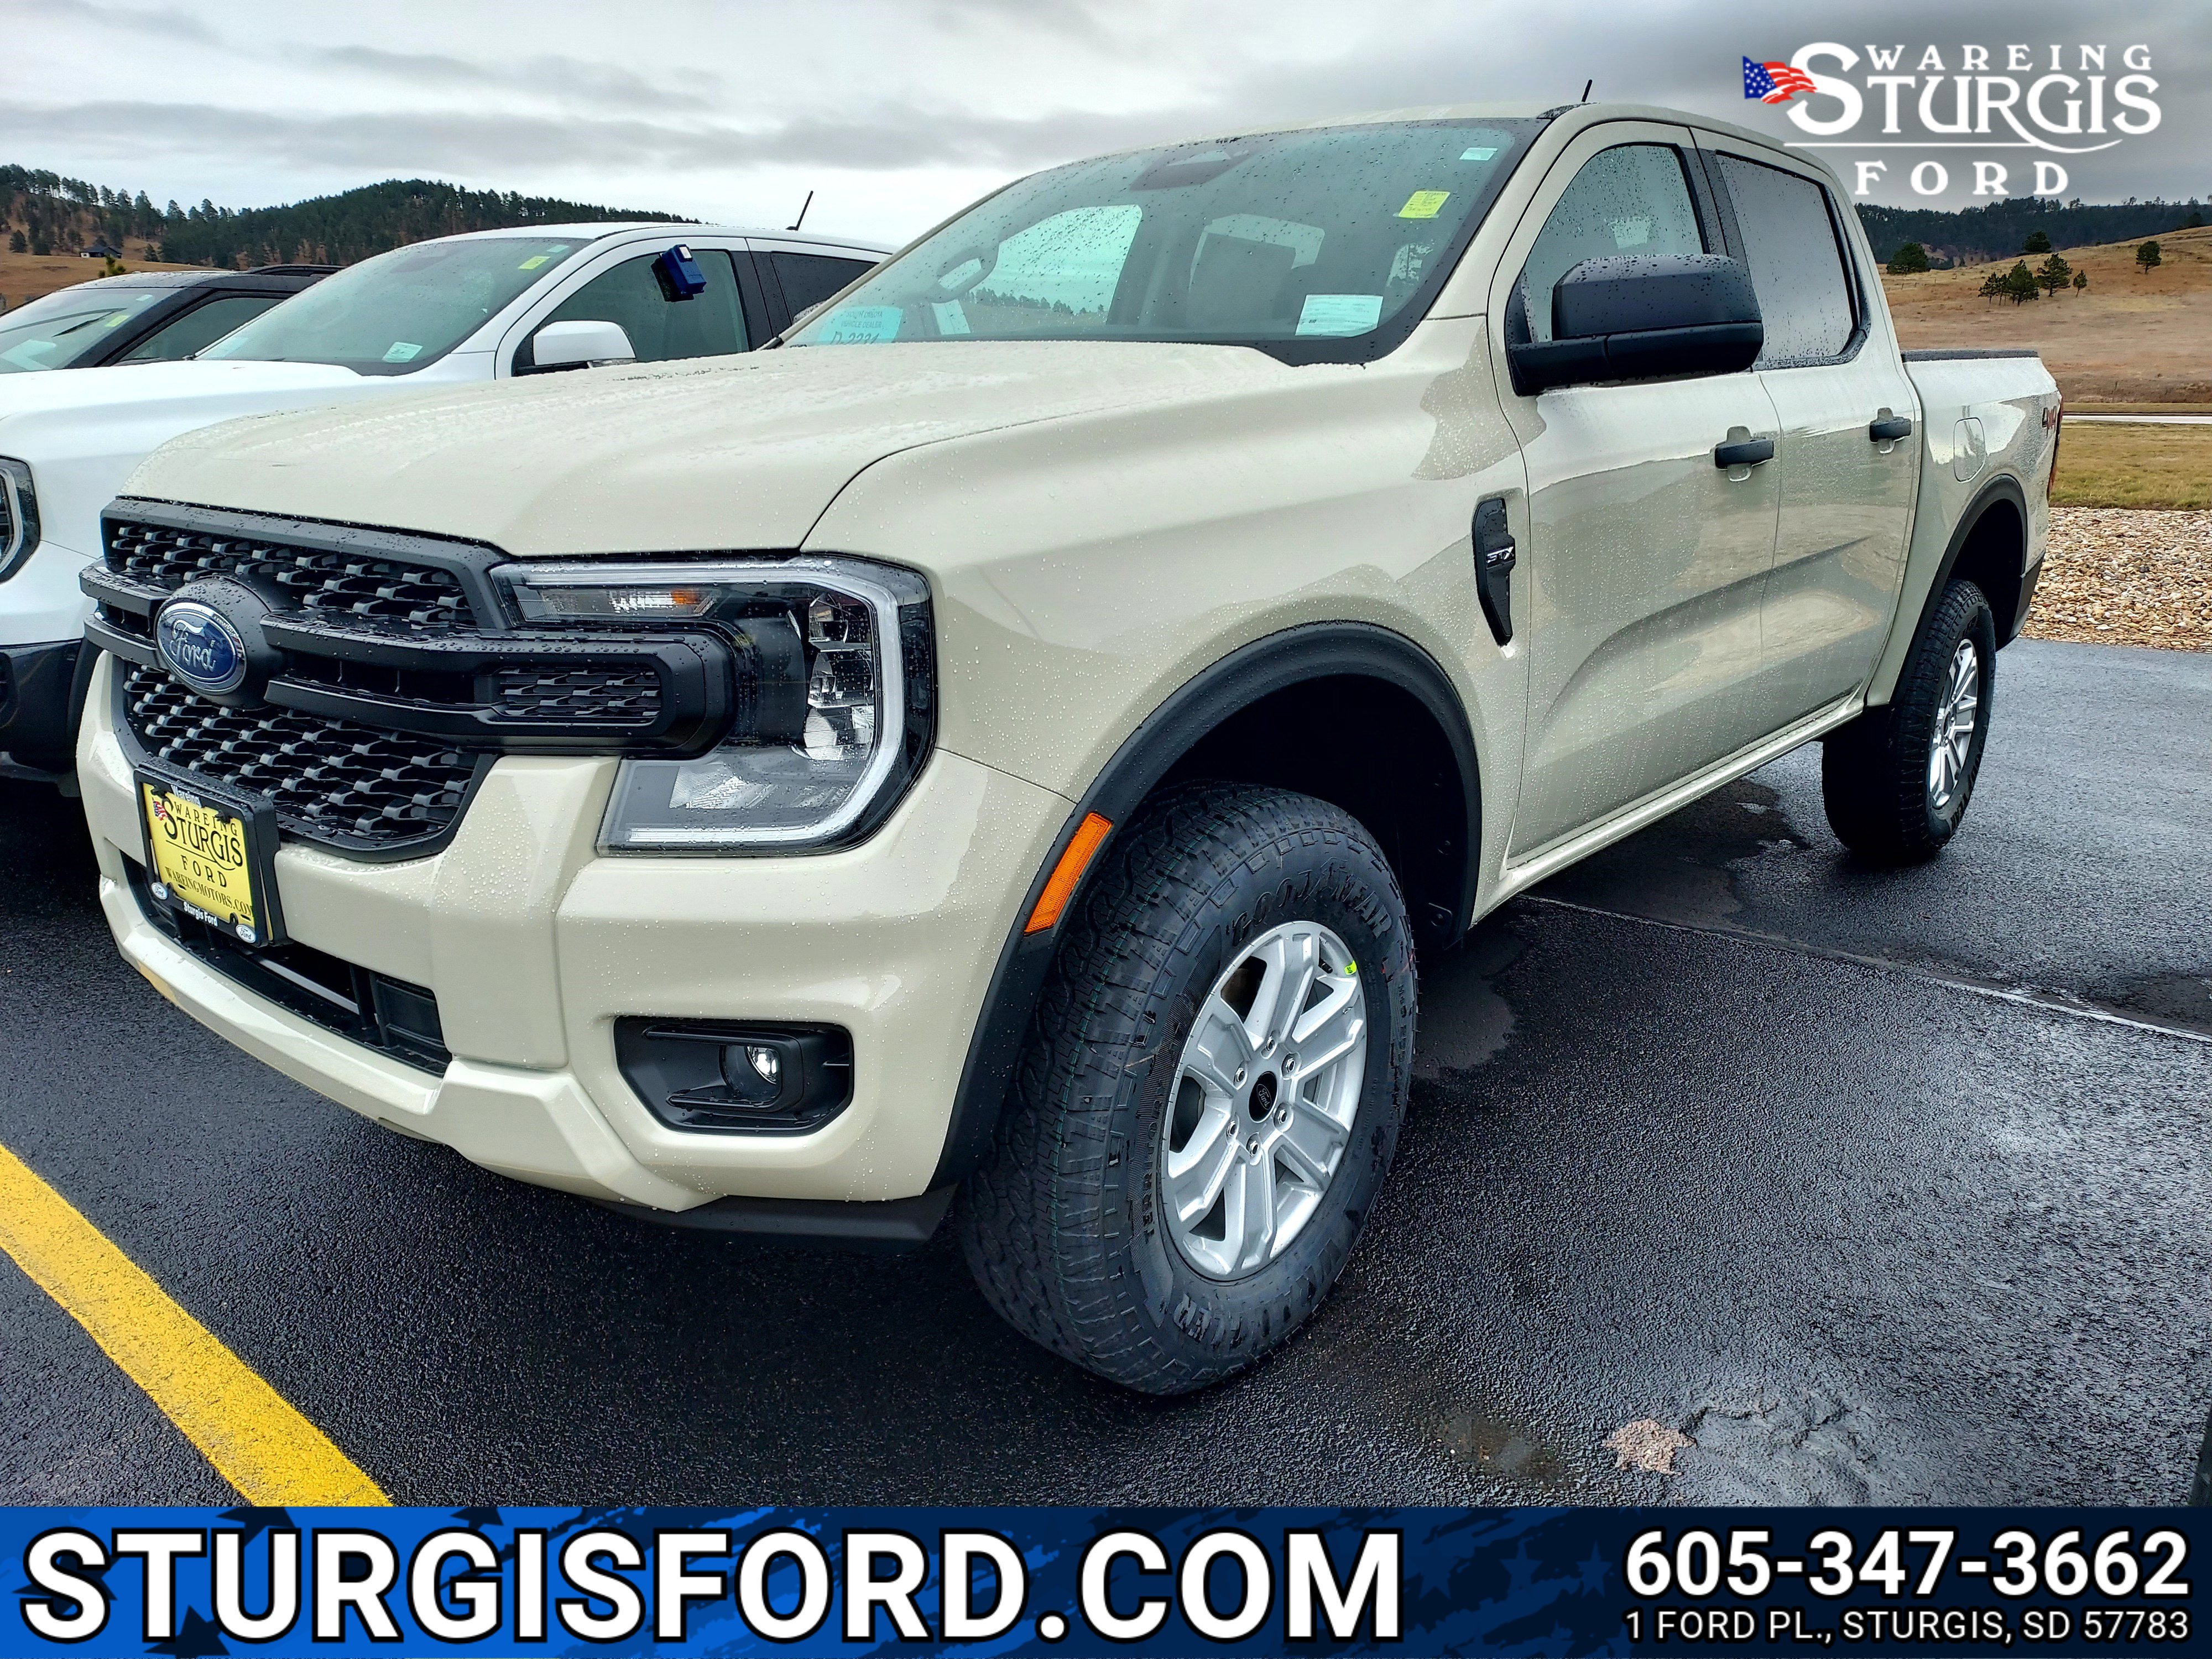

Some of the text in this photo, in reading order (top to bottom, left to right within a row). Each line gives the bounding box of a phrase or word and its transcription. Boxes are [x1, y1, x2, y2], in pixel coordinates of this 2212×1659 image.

[170, 619, 217, 672] Ford
[163, 796, 243, 870] STURGIS
[174, 801, 238, 837] WAREING
[180, 854, 228, 888] FORD
[184, 901, 218, 932] Sturgis Ford
[1142, 1079, 1166, 1245] TERRITORY
